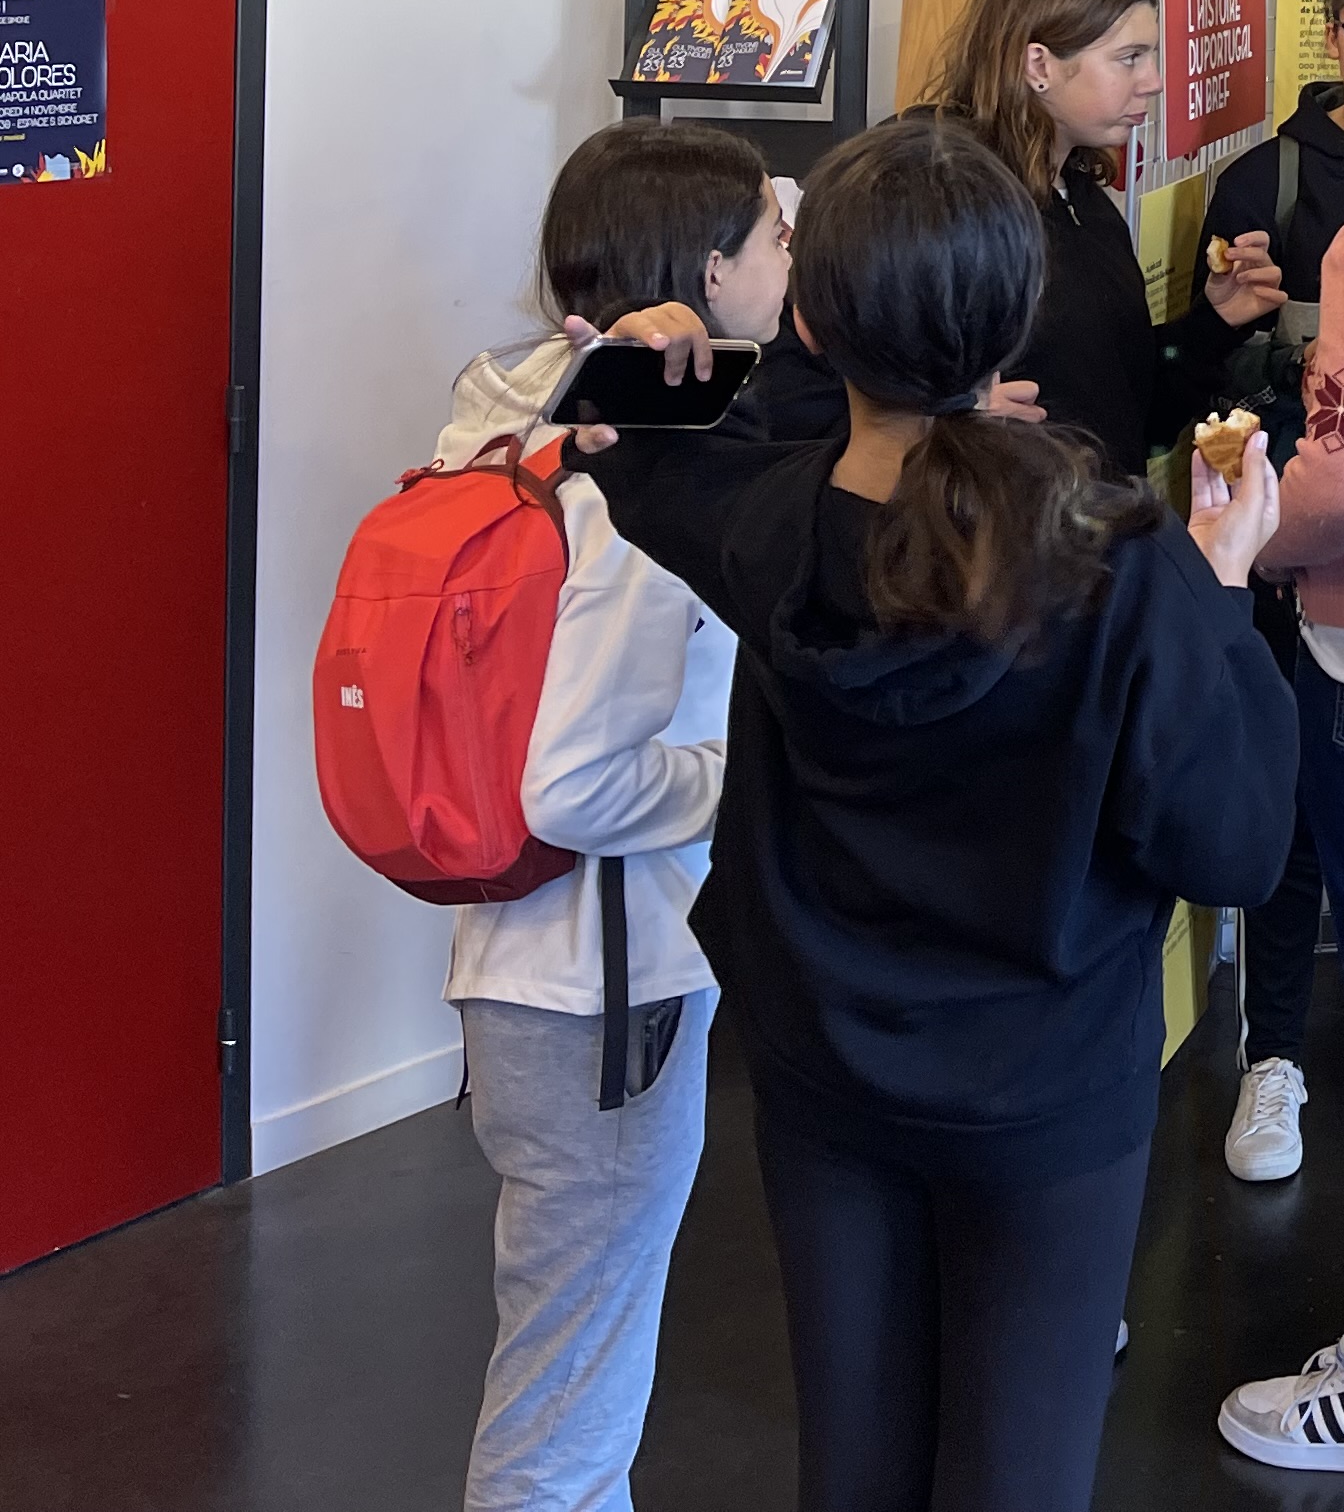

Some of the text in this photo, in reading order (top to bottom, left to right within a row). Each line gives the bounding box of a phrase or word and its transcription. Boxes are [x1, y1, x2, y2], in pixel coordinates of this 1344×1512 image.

[0, 41, 49, 65] ARIA
[38, 87, 83, 101] QUARTET
[1188, 71, 1231, 121] EN BREF
[24, 106, 30, 115] 4
[31, 103, 78, 116] NOVEMBRE
[17, 117, 49, 129] ESPACE
[57, 113, 99, 126] SIGNORET
